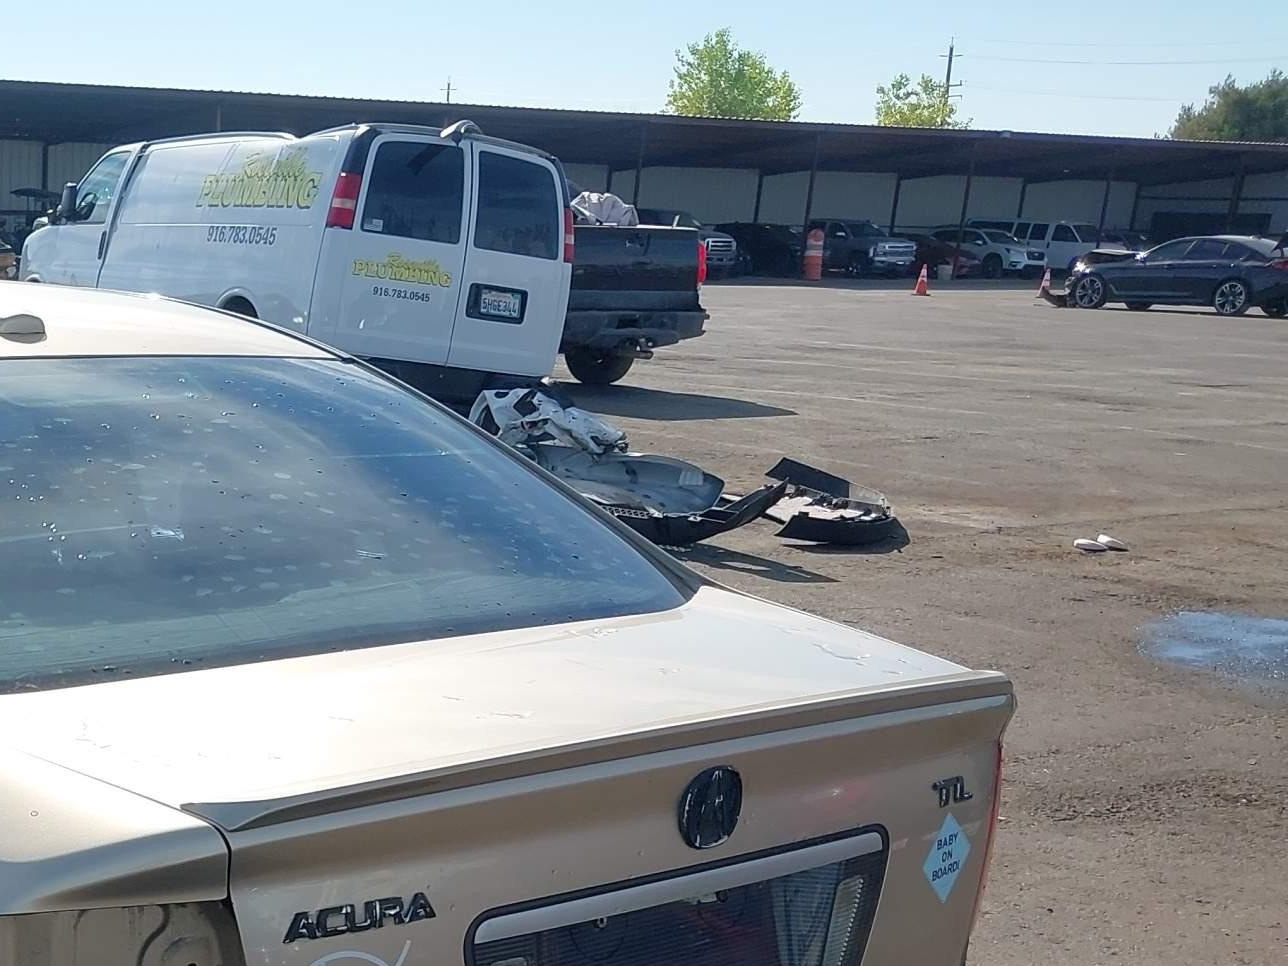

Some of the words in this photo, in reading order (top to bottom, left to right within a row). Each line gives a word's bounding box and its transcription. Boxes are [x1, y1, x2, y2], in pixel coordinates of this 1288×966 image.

[195, 173, 322, 209] PLUMBING
[207, 225, 277, 246] 916.783.0545
[352, 259, 452, 288] PLUMBING
[373, 286, 430, 302] 916.783.0545
[932, 776, 973, 808] TL
[937, 832, 958, 850] BABY
[941, 849, 952, 862] ON
[932, 860, 960, 881] BOARD!
[282, 892, 436, 943] ACURA
